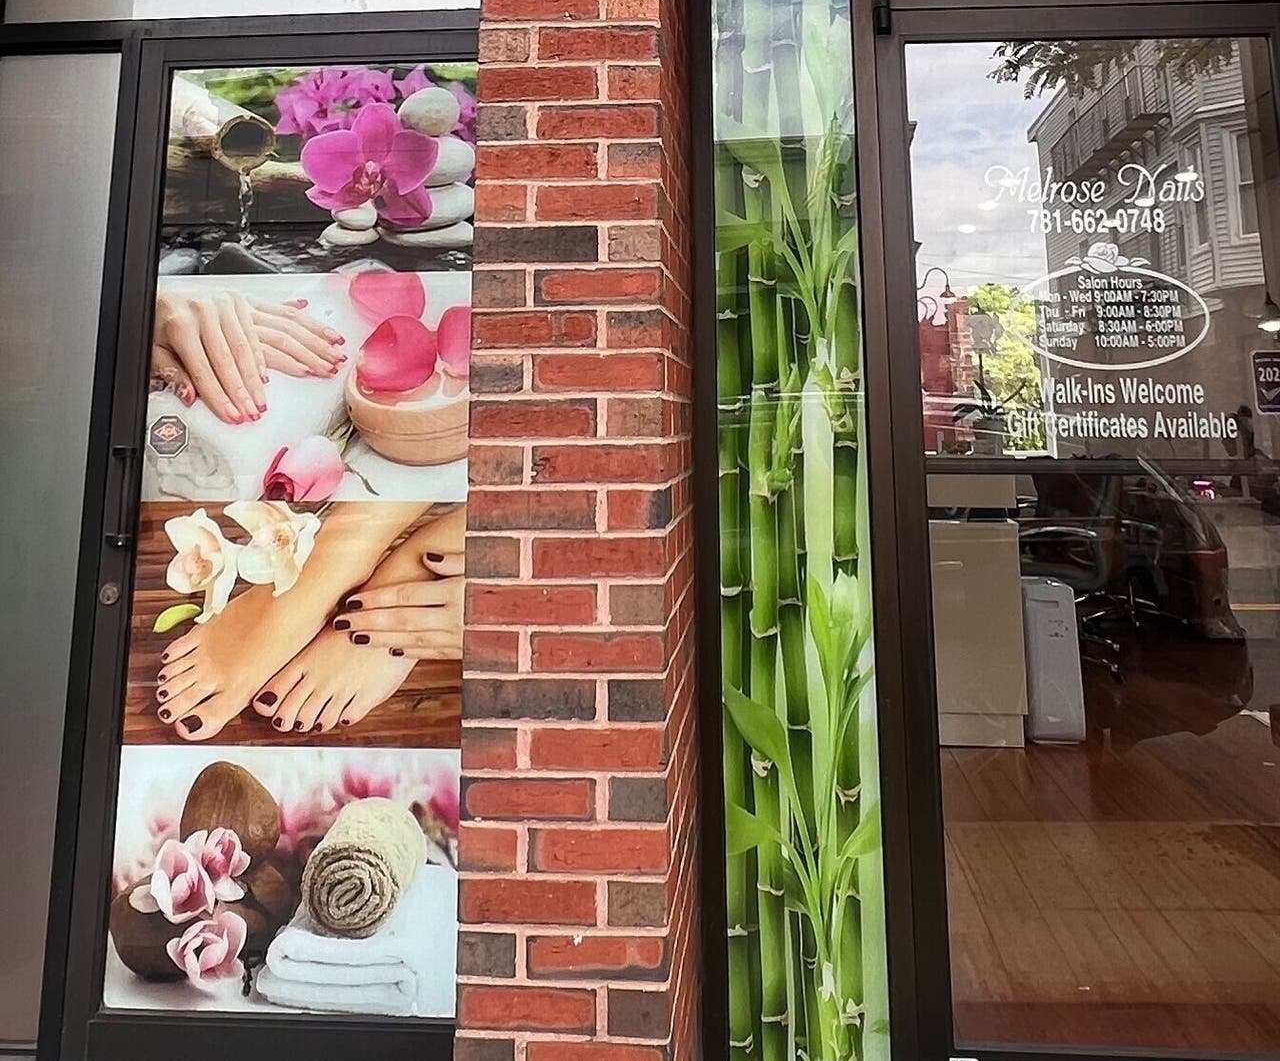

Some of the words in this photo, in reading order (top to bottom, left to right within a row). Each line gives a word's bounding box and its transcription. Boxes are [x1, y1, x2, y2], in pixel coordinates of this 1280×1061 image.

[984, 165, 1106, 205] Melrose
[1027, 208, 1166, 234] 781-662-0748
[1077, 276, 1109, 289] Salon
[1110, 276, 1143, 289] Hours
[1069, 290, 1092, 303] Wed
[1094, 290, 1133, 303] 9:00AM
[1141, 290, 1179, 303] 7:30PM
[1038, 305, 1060, 318] Thu
[1072, 306, 1086, 318] Fri
[1096, 305, 1135, 318] 9:00AM
[1143, 306, 1182, 318] 8:30PM
[1038, 320, 1085, 335] Saturday
[1098, 320, 1137, 333] 8:30AM
[1038, 335, 1078, 350] Sunday
[1094, 335, 1139, 348] 10:00AM
[1147, 335, 1186, 348] 5:00PM
[1040, 377, 1115, 404] Walk-Ins
[1120, 377, 1205, 404] Welcome
[1006, 410, 1040, 438] Gift
[1042, 410, 1149, 438] Certificates
[1153, 410, 1238, 439] Available
